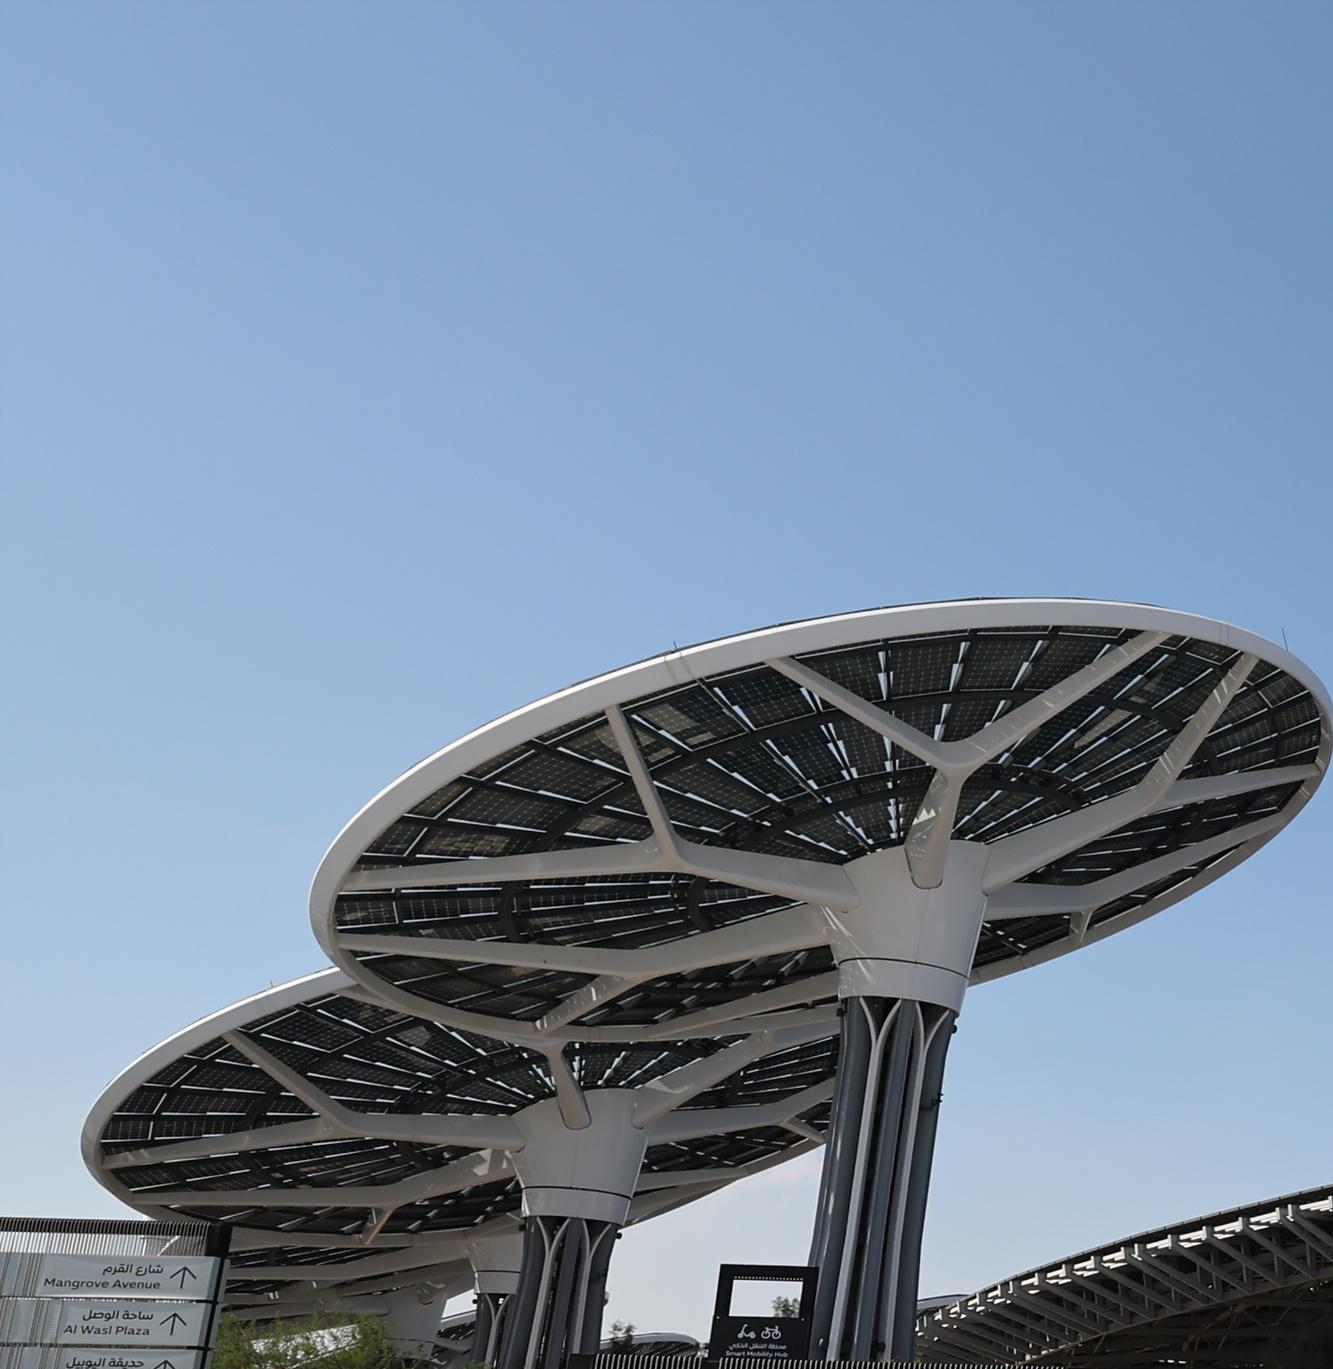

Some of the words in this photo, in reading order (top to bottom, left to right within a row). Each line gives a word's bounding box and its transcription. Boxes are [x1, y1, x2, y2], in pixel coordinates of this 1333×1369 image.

[102, 1264, 133, 1276] القرم
[135, 1264, 164, 1277] شارع
[43, 1278, 109, 1290] Mangrove
[112, 1280, 161, 1289] Avenue
[82, 1310, 119, 1321] الوصل
[122, 1310, 154, 1321] ساحة
[63, 1325, 77, 1334] Al
[80, 1325, 113, 1335] Wasl
[115, 1326, 150, 1336] Plaza
[108, 1357, 144, 1369] حديقة
